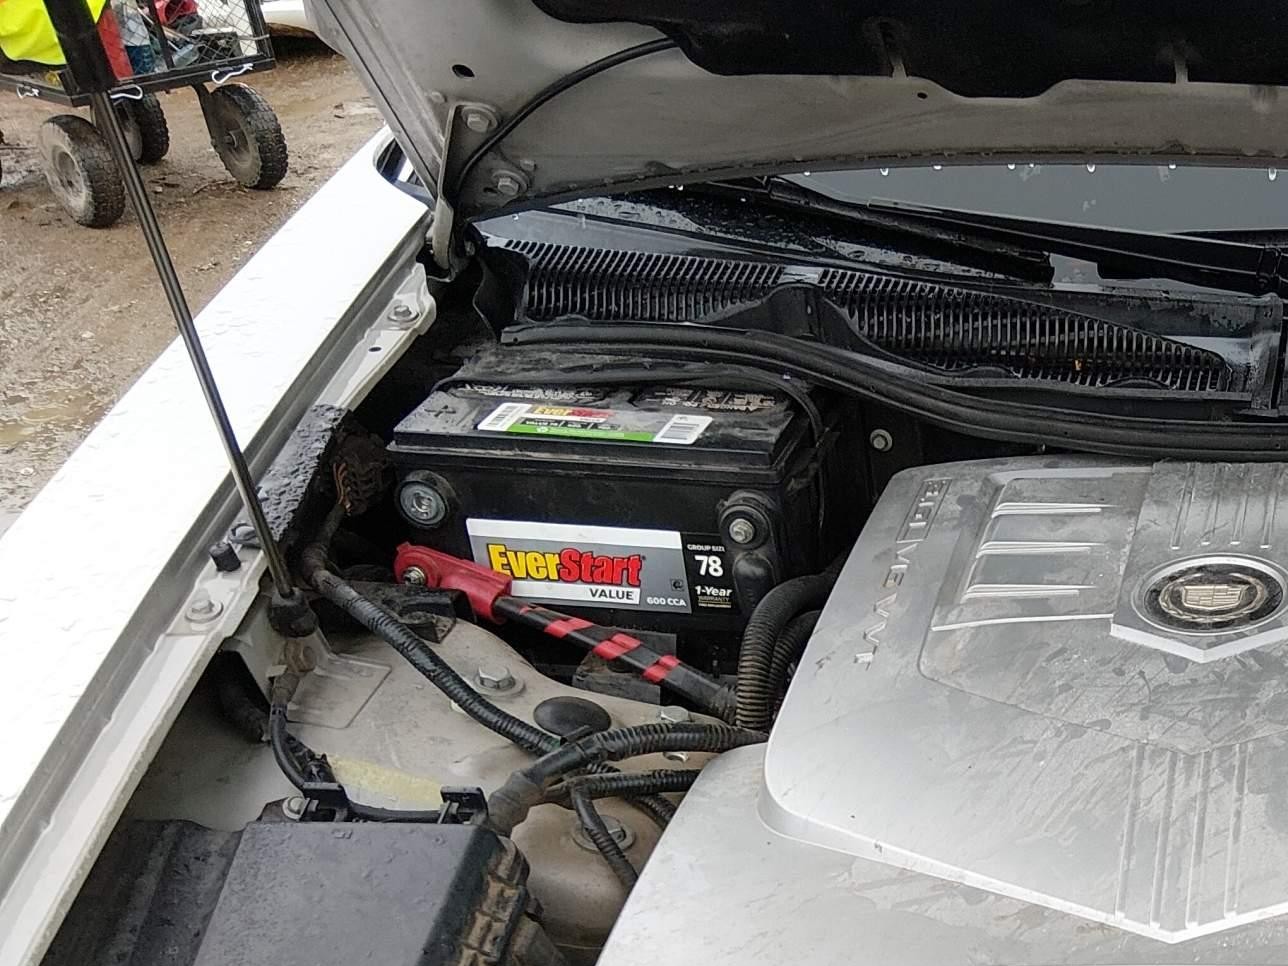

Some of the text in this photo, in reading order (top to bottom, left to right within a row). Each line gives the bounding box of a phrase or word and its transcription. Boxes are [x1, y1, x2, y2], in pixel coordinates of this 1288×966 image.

[487, 543, 643, 587] EverStart
[694, 555, 724, 577] 78
[588, 588, 634, 601] VALUE
[694, 585, 733, 597] 1-Year
[646, 597, 687, 607] 600 CCA
